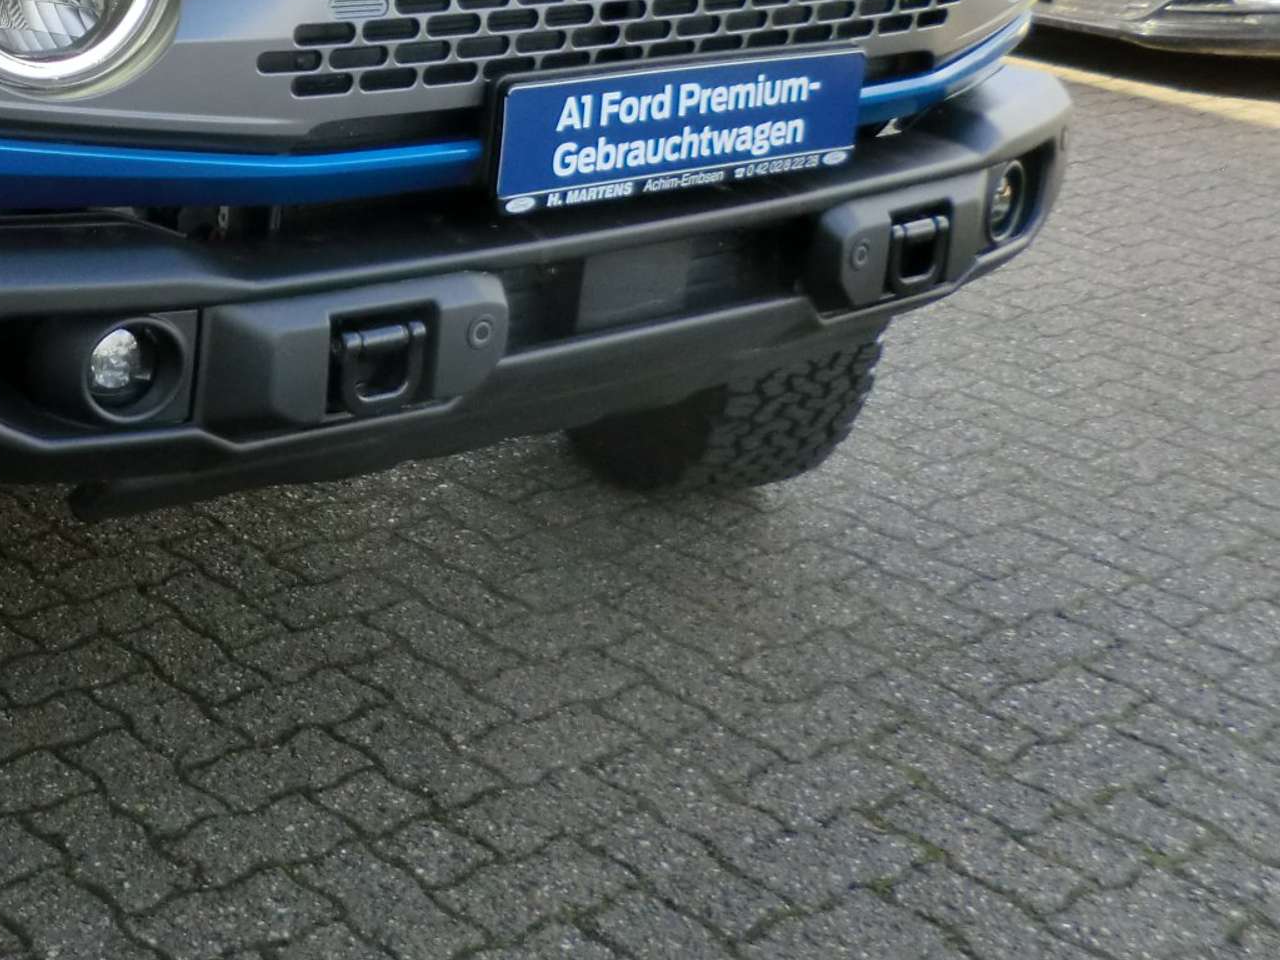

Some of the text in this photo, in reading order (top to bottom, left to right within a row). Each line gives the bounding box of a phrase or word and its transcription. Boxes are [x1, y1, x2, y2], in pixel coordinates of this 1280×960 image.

[556, 73, 822, 132] A1 Ford Premium-
[552, 118, 805, 177] Gebrauchtwagen
[546, 192, 563, 207] H.
[566, 181, 634, 205] MARTENS
[643, 170, 725, 192] Achim-Embsen
